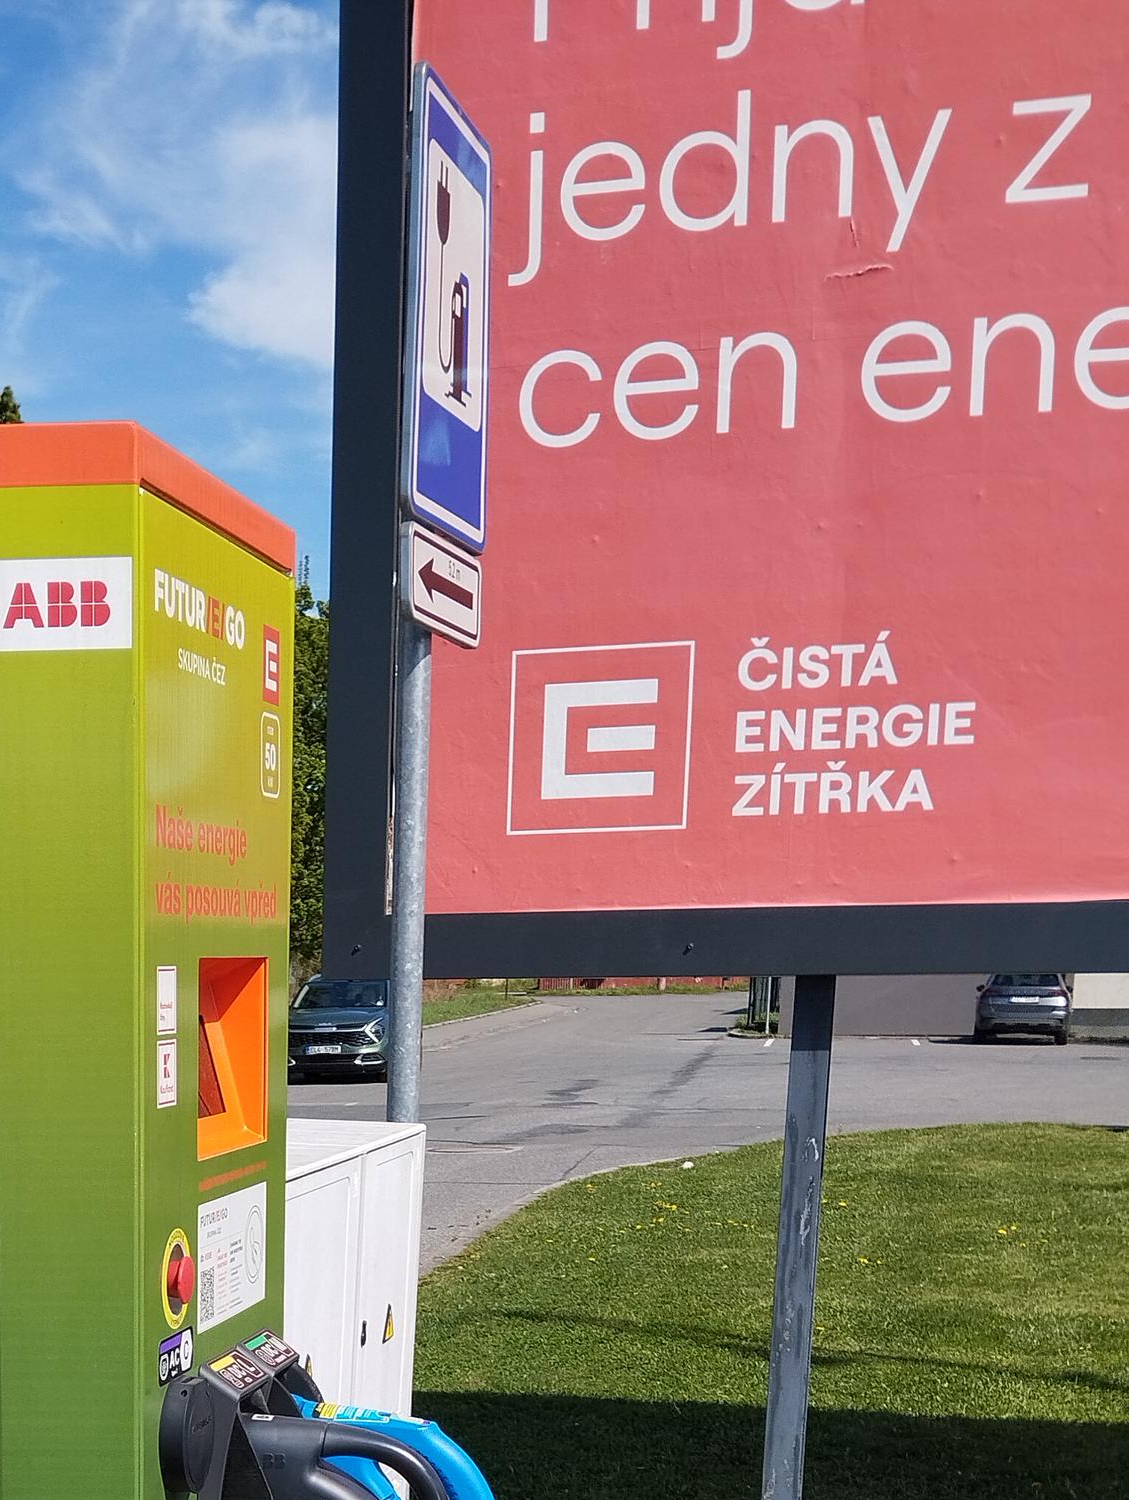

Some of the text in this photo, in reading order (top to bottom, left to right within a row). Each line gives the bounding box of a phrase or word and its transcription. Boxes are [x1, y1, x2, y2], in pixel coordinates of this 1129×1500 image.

[508, 90, 1092, 286] jedny z
[519, 306, 1129, 448] cen ene
[2, 580, 111, 629] ABB
[177, 648, 211, 680] SKUPINA
[736, 630, 899, 691] ČISTÁ
[734, 702, 977, 753] ENERGIE
[264, 742, 276, 772] 50
[731, 760, 935, 816] ZÍTŘKA
[156, 801, 248, 866] Naše energie
[155, 871, 278, 927] vás posouvá vpřed
[169, 1347, 180, 1369] AC
[183, 1340, 189, 1360] C
